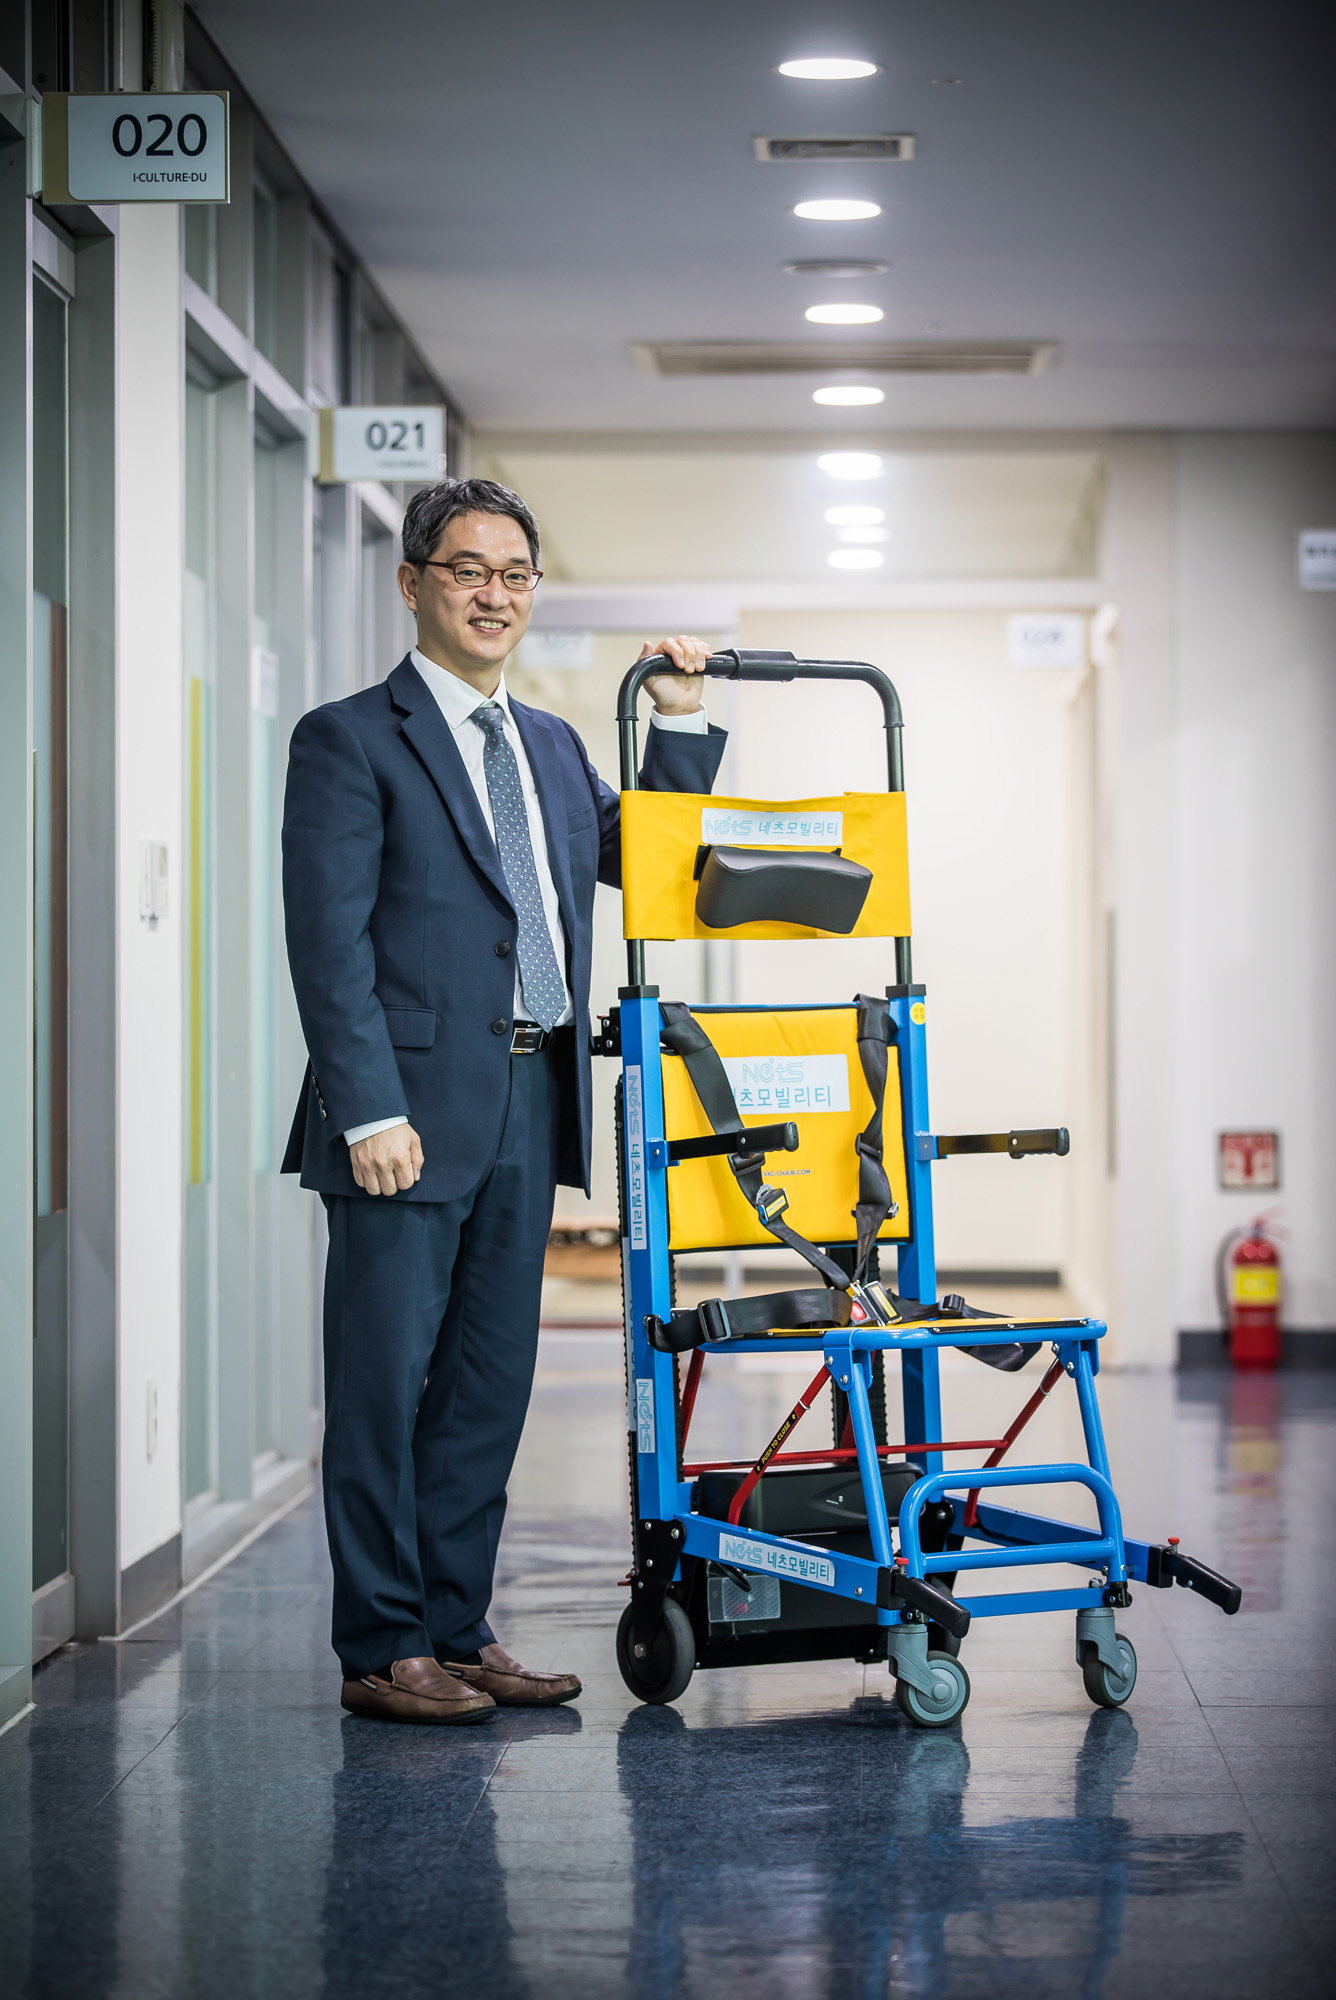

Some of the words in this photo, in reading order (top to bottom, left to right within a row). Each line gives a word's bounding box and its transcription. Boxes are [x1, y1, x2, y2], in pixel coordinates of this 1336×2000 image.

[112, 113, 207, 157] 020
[365, 420, 424, 451] 021
[758, 821, 838, 837] 네츠모빌리티
[733, 1085, 831, 1108] 츠모빌리티
[762, 1168, 811, 1177] VAC-CHAIR.COM
[631, 1143, 643, 1241] 네츠모빌리티
[761, 1446, 773, 1464] PUSH
[771, 1439, 778, 1449] TO
[776, 1421, 791, 1441] CLOSE
[767, 1551, 830, 1582] 네츠모빌리티
